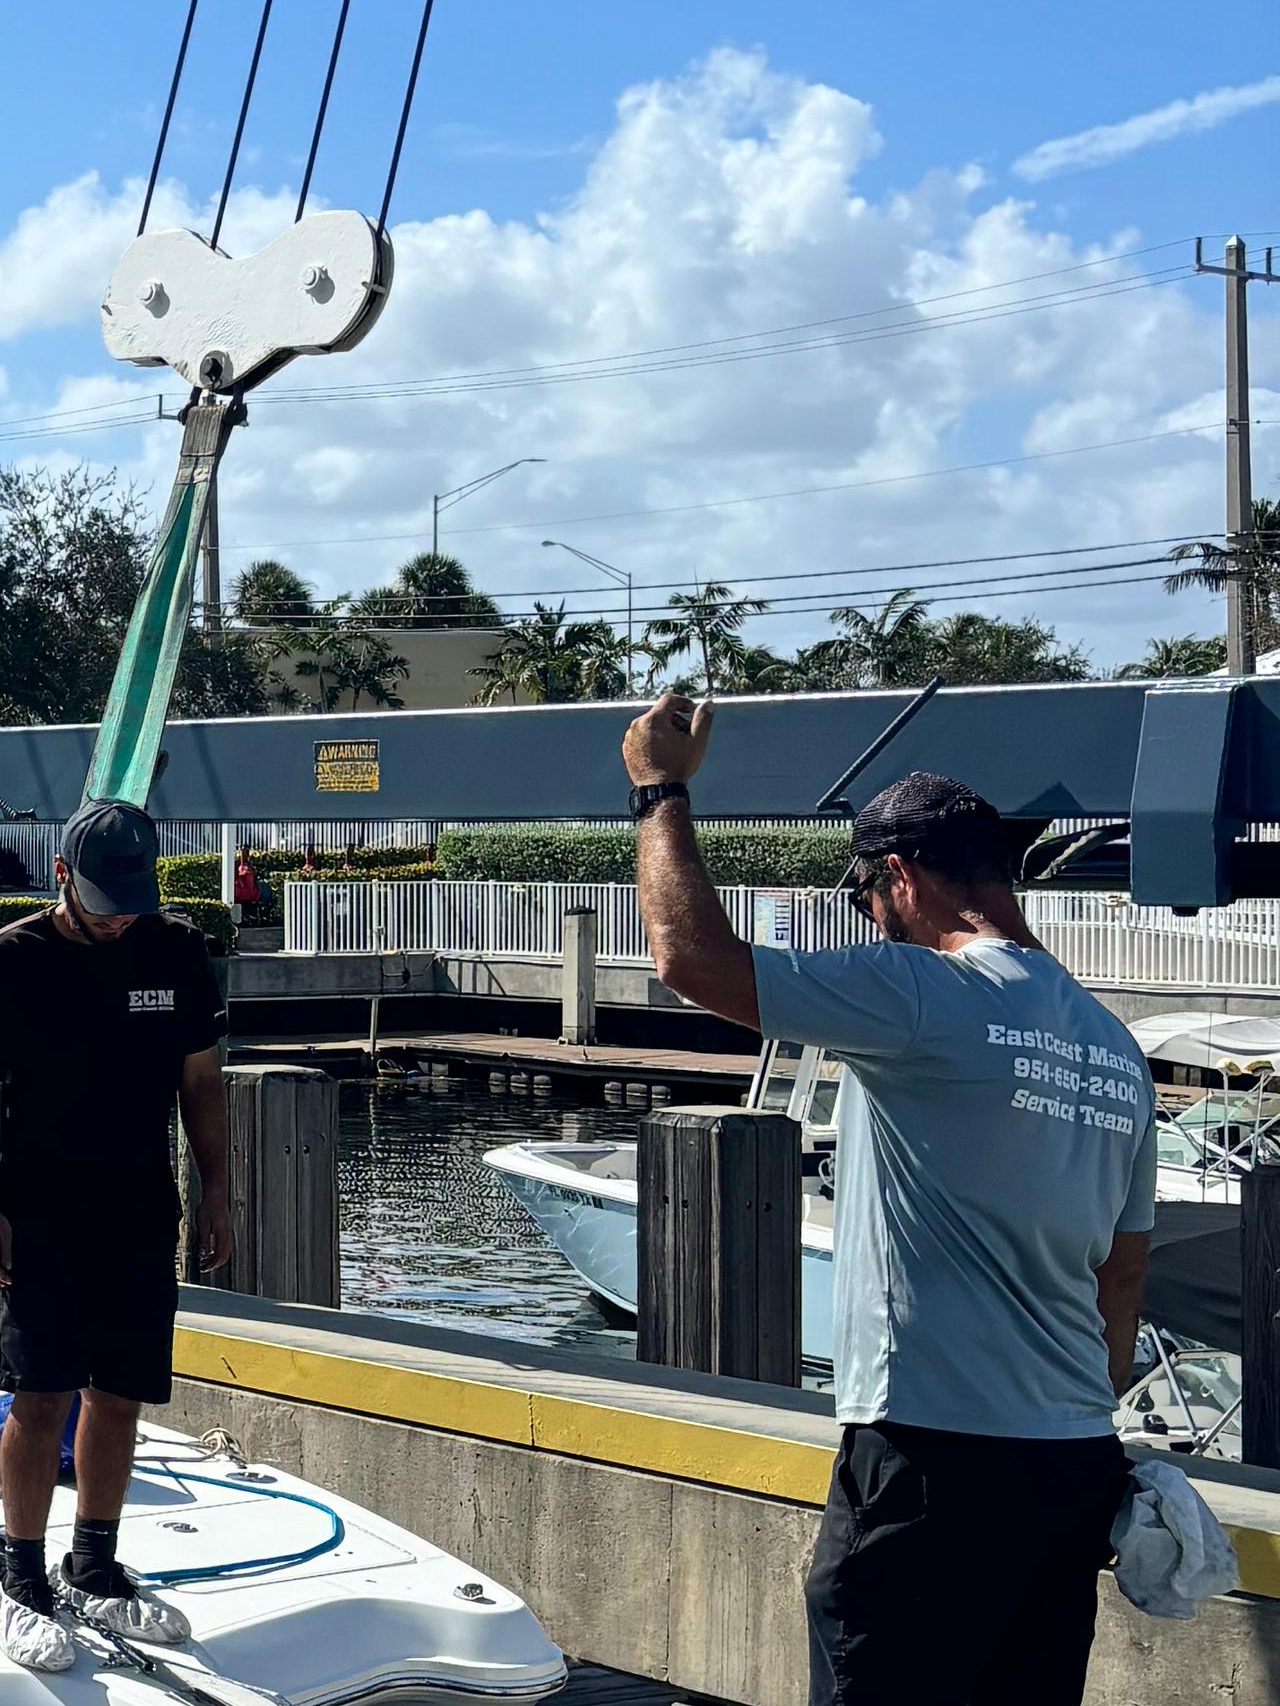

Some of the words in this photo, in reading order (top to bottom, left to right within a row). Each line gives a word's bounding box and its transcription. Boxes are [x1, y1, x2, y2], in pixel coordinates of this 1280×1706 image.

[128, 989, 175, 1006] ECM
[987, 1023, 1044, 1049] East
[1043, 1032, 1083, 1063] Coast
[1010, 1088, 1076, 1123] Service
[1079, 1104, 1134, 1136] Team
